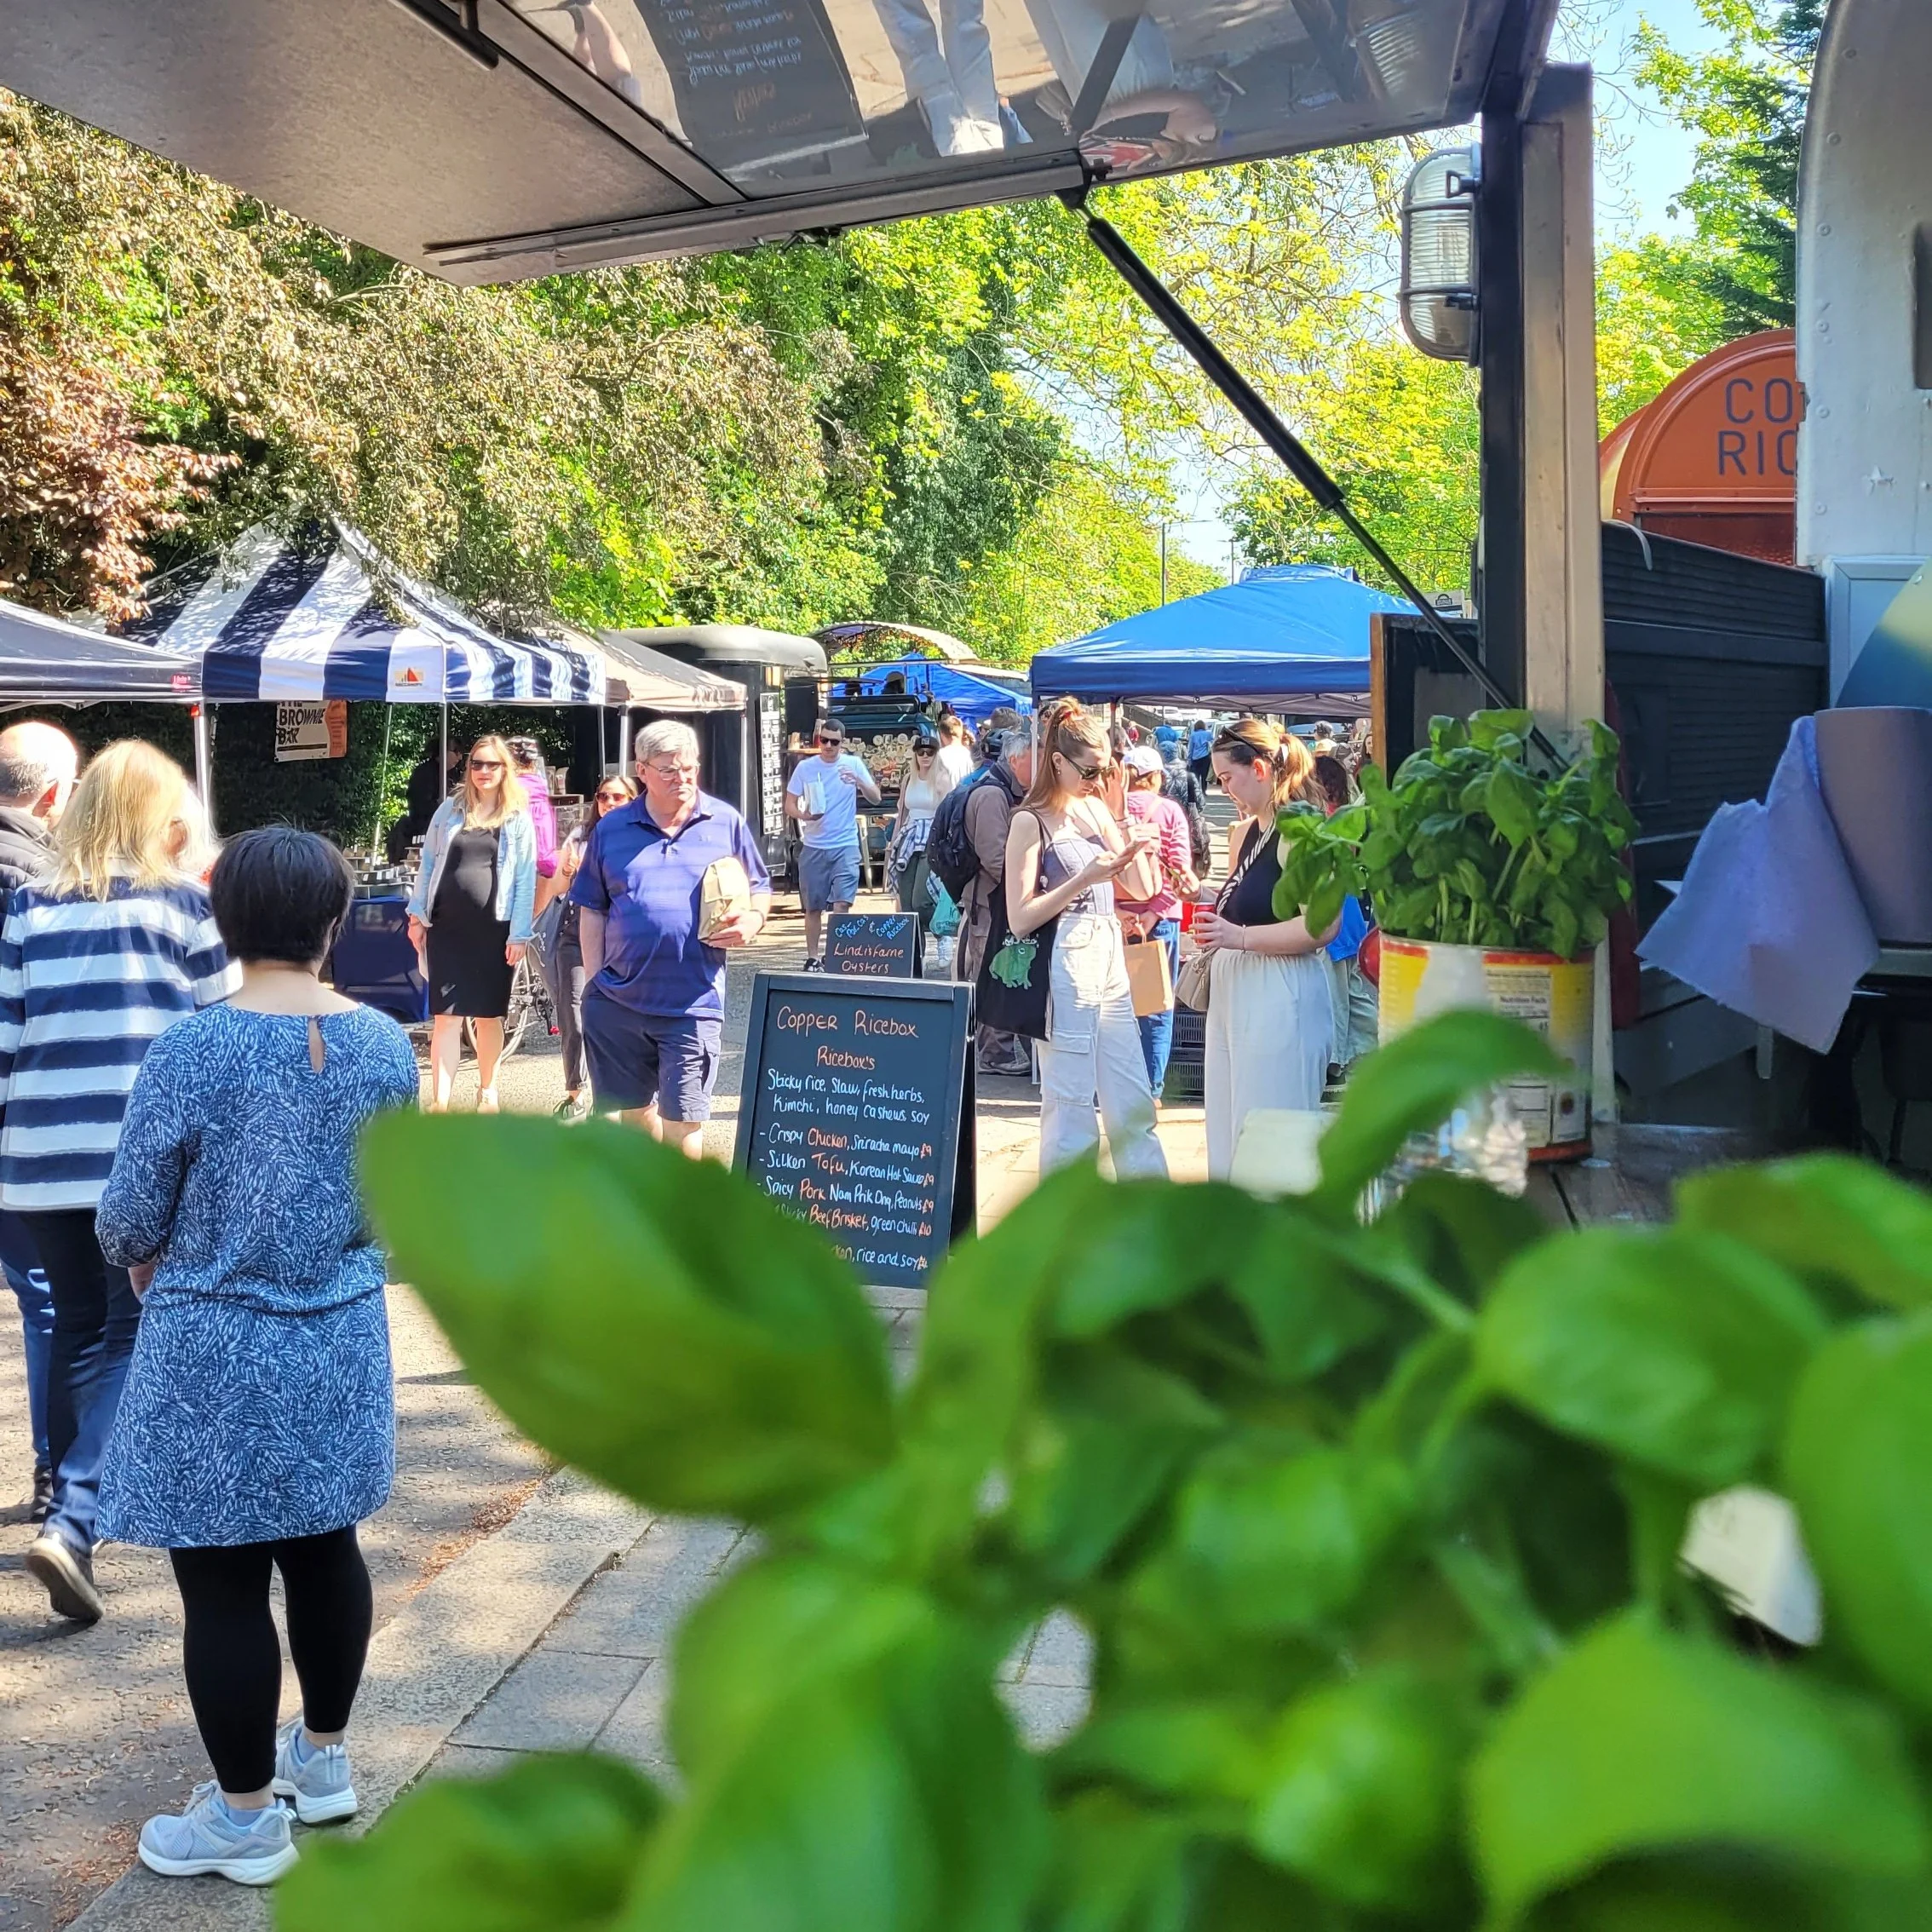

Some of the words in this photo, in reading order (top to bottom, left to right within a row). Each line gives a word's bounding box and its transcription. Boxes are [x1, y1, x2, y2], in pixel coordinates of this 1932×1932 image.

[279, 708, 325, 726] BROWNIE
[842, 960, 889, 974] Oysters
[854, 1009, 920, 1038] Ricebox
[816, 1045, 876, 1070] Ricebox's
[768, 1067, 802, 1093] Sticky
[862, 1078, 890, 1102] fresh
[825, 1097, 859, 1122] honey
[768, 1122, 802, 1145] Crispy
[892, 1142, 920, 1162] mayo
[767, 1150, 806, 1170] Silken
[848, 1160, 886, 1178] Korean
[886, 1164, 902, 1182] Hot
[763, 1176, 794, 1199] Spicy
[800, 1177, 826, 1202] Pork
[830, 1183, 852, 1203] Nam
[854, 1183, 873, 1204] Prik
[809, 1204, 831, 1229] Beef
[871, 1216, 896, 1236] green
[856, 1246, 876, 1263] rice
[877, 1251, 900, 1267] and
[900, 1254, 920, 1272] soy
